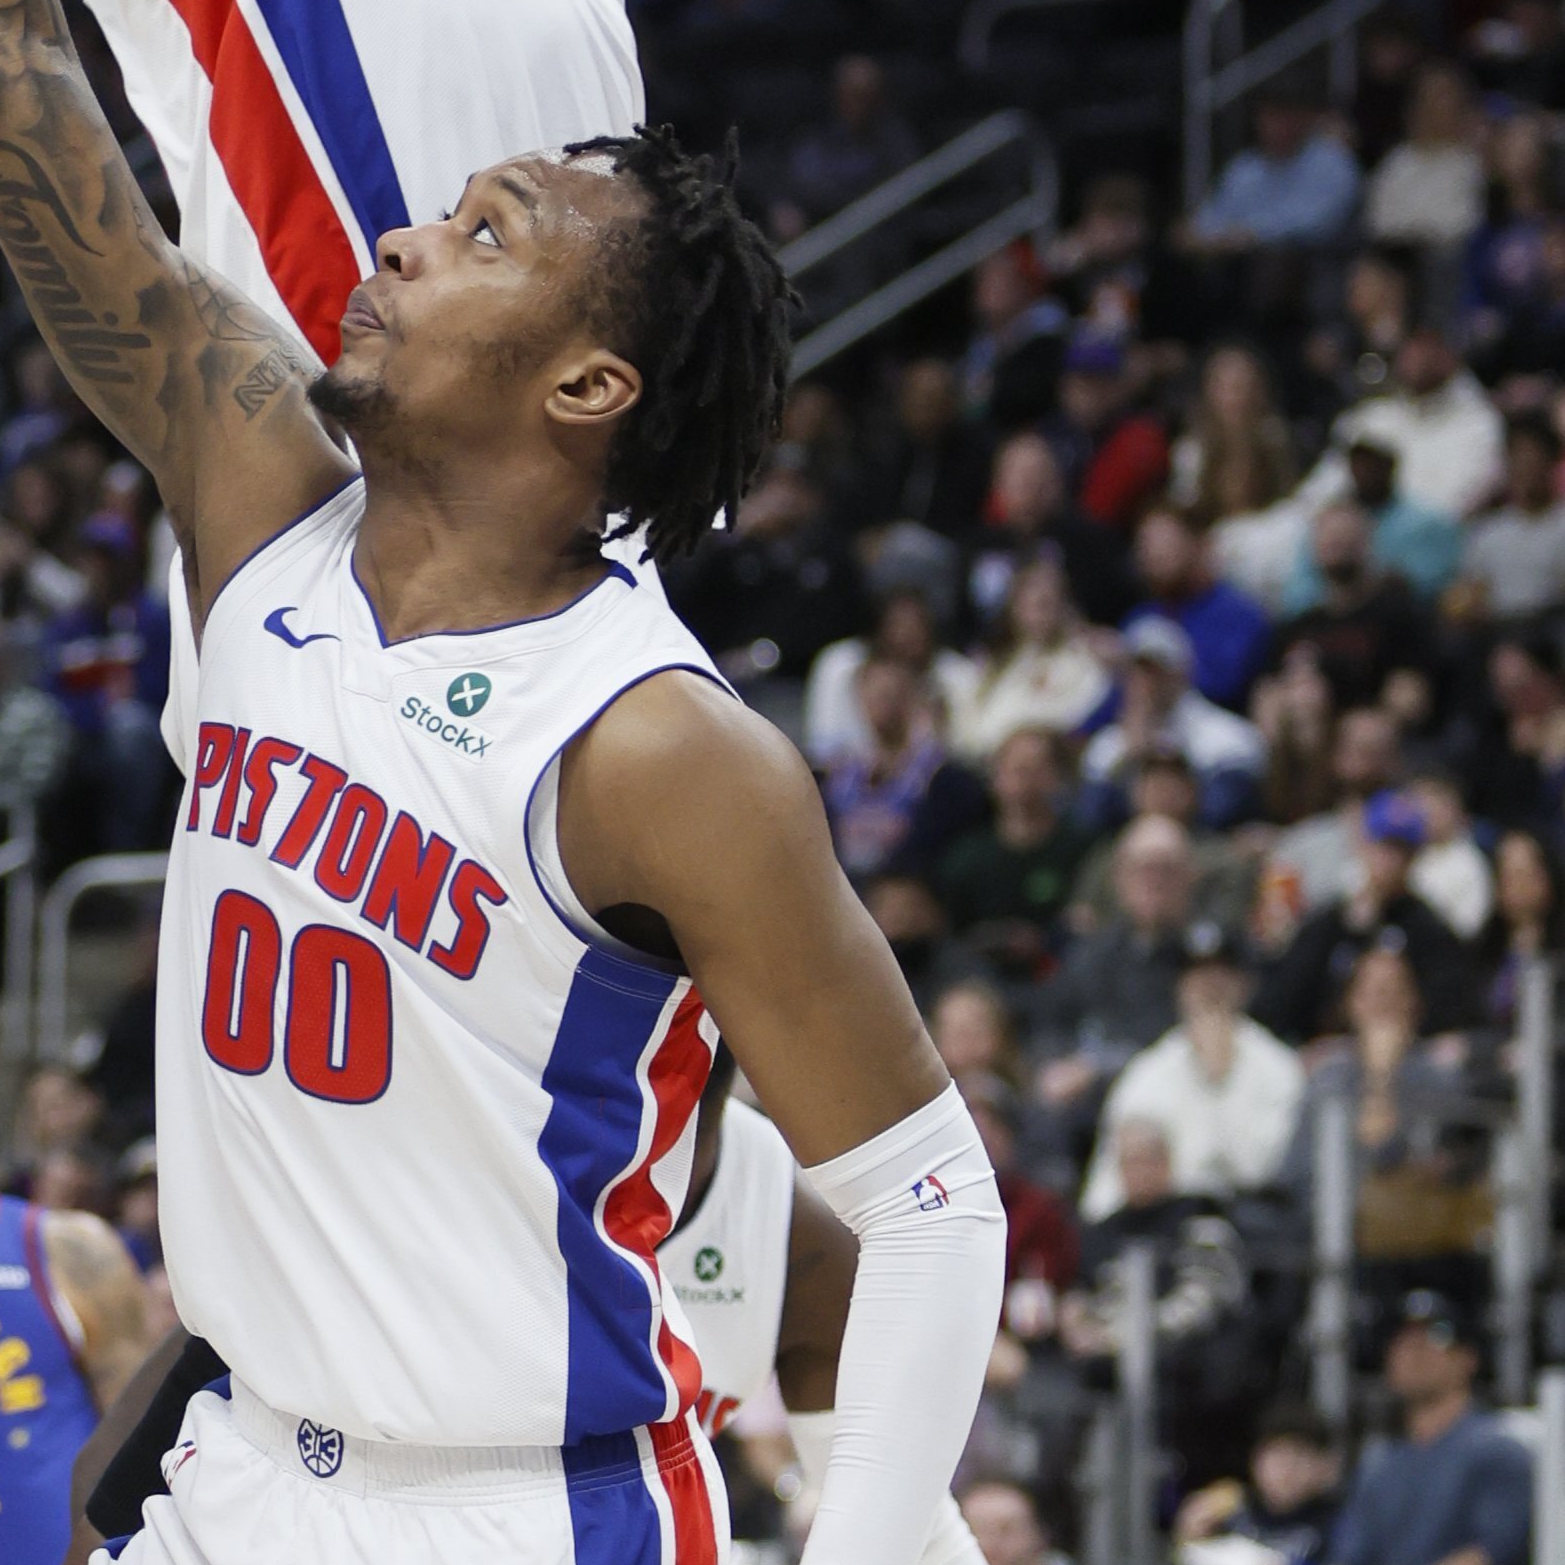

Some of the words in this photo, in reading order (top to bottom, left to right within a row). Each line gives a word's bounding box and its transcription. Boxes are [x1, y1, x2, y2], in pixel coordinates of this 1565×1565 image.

[400, 696, 494, 758] StockX
[185, 721, 509, 981] PISTONS
[202, 888, 394, 1106] 00
